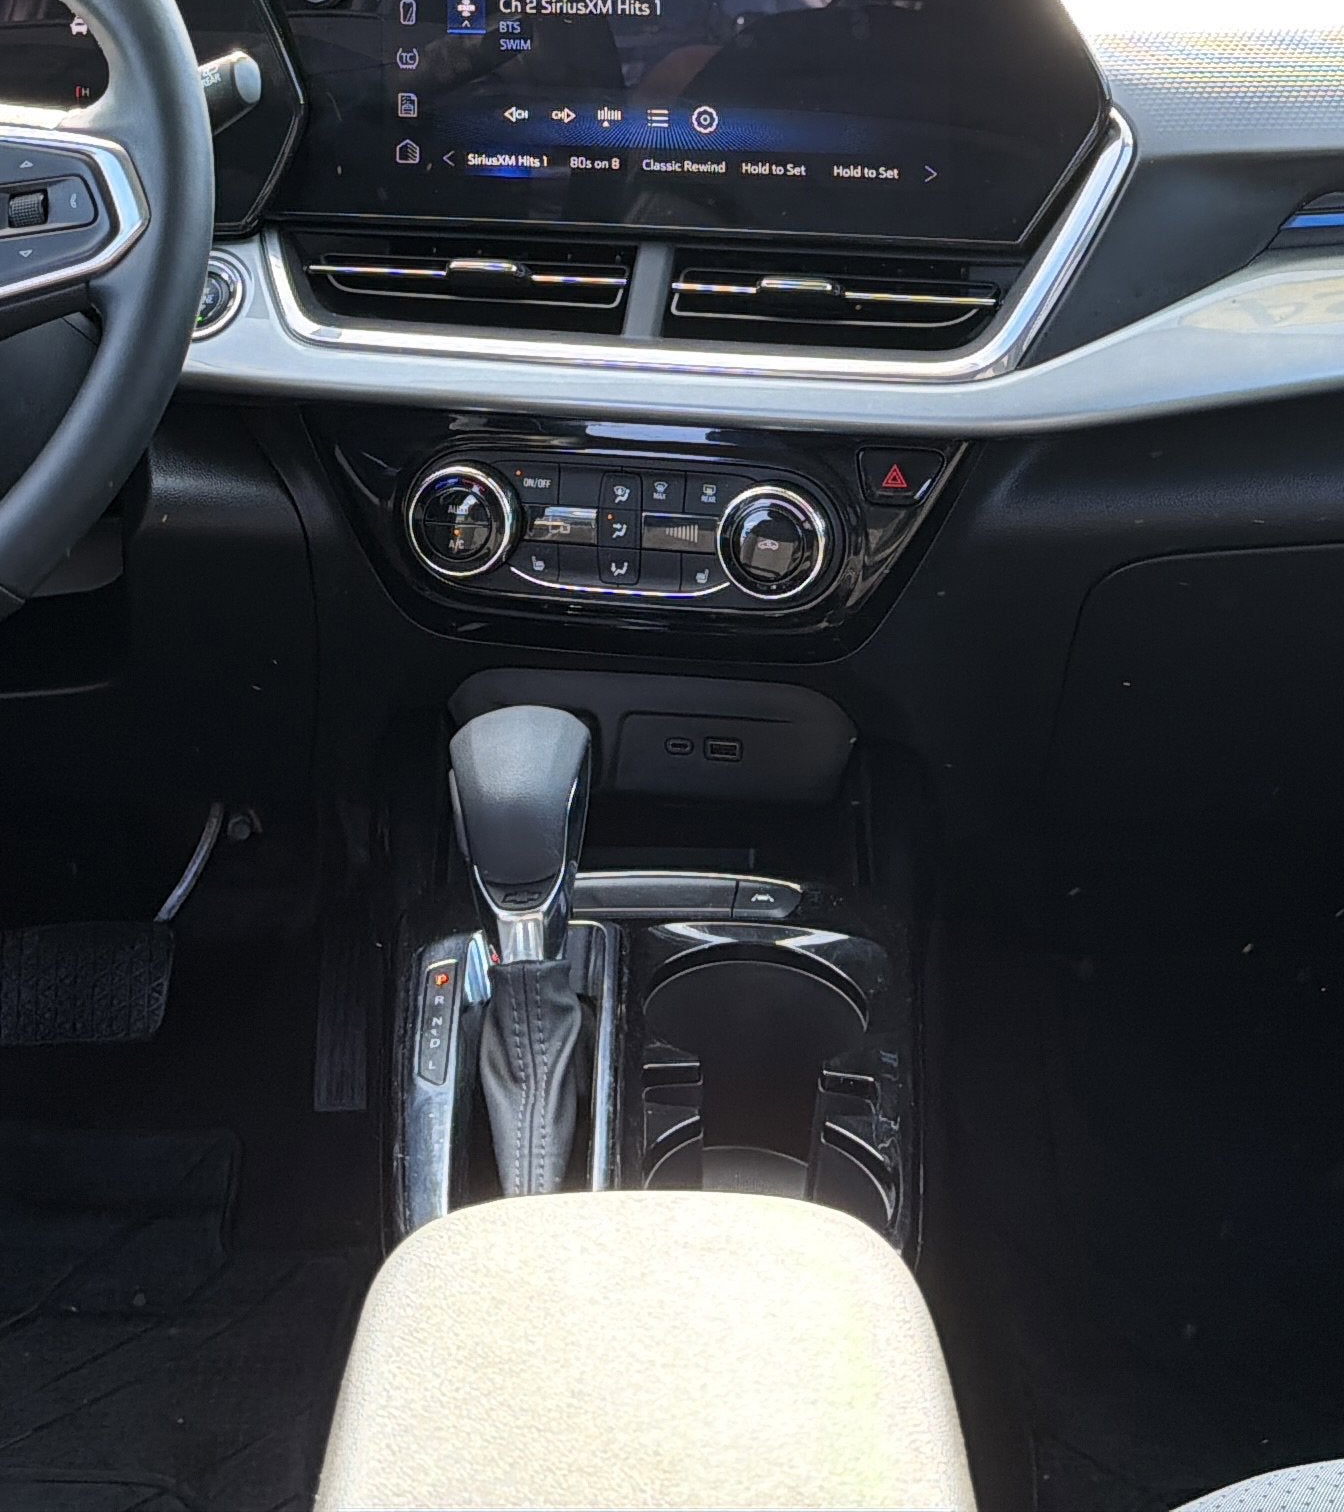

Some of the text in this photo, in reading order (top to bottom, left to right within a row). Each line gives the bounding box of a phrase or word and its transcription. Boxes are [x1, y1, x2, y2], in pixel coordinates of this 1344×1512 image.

[654, 0, 662, 16] 1
[499, 21, 521, 34] BTS
[499, 39, 532, 51] SWIM
[466, 152, 516, 166] SiriusXM
[519, 154, 541, 168] Hits
[569, 156, 621, 170] 80s on 8
[642, 159, 726, 173] Classic Rewind
[741, 162, 806, 176] Hold to Set
[833, 165, 899, 180] Hold to Set
[522, 477, 552, 489] ON/OFF
[448, 539, 465, 550] A/C
[434, 995, 445, 1006] R
[431, 1016, 443, 1027] N
[429, 1038, 441, 1049] D
[428, 1060, 437, 1070] L
